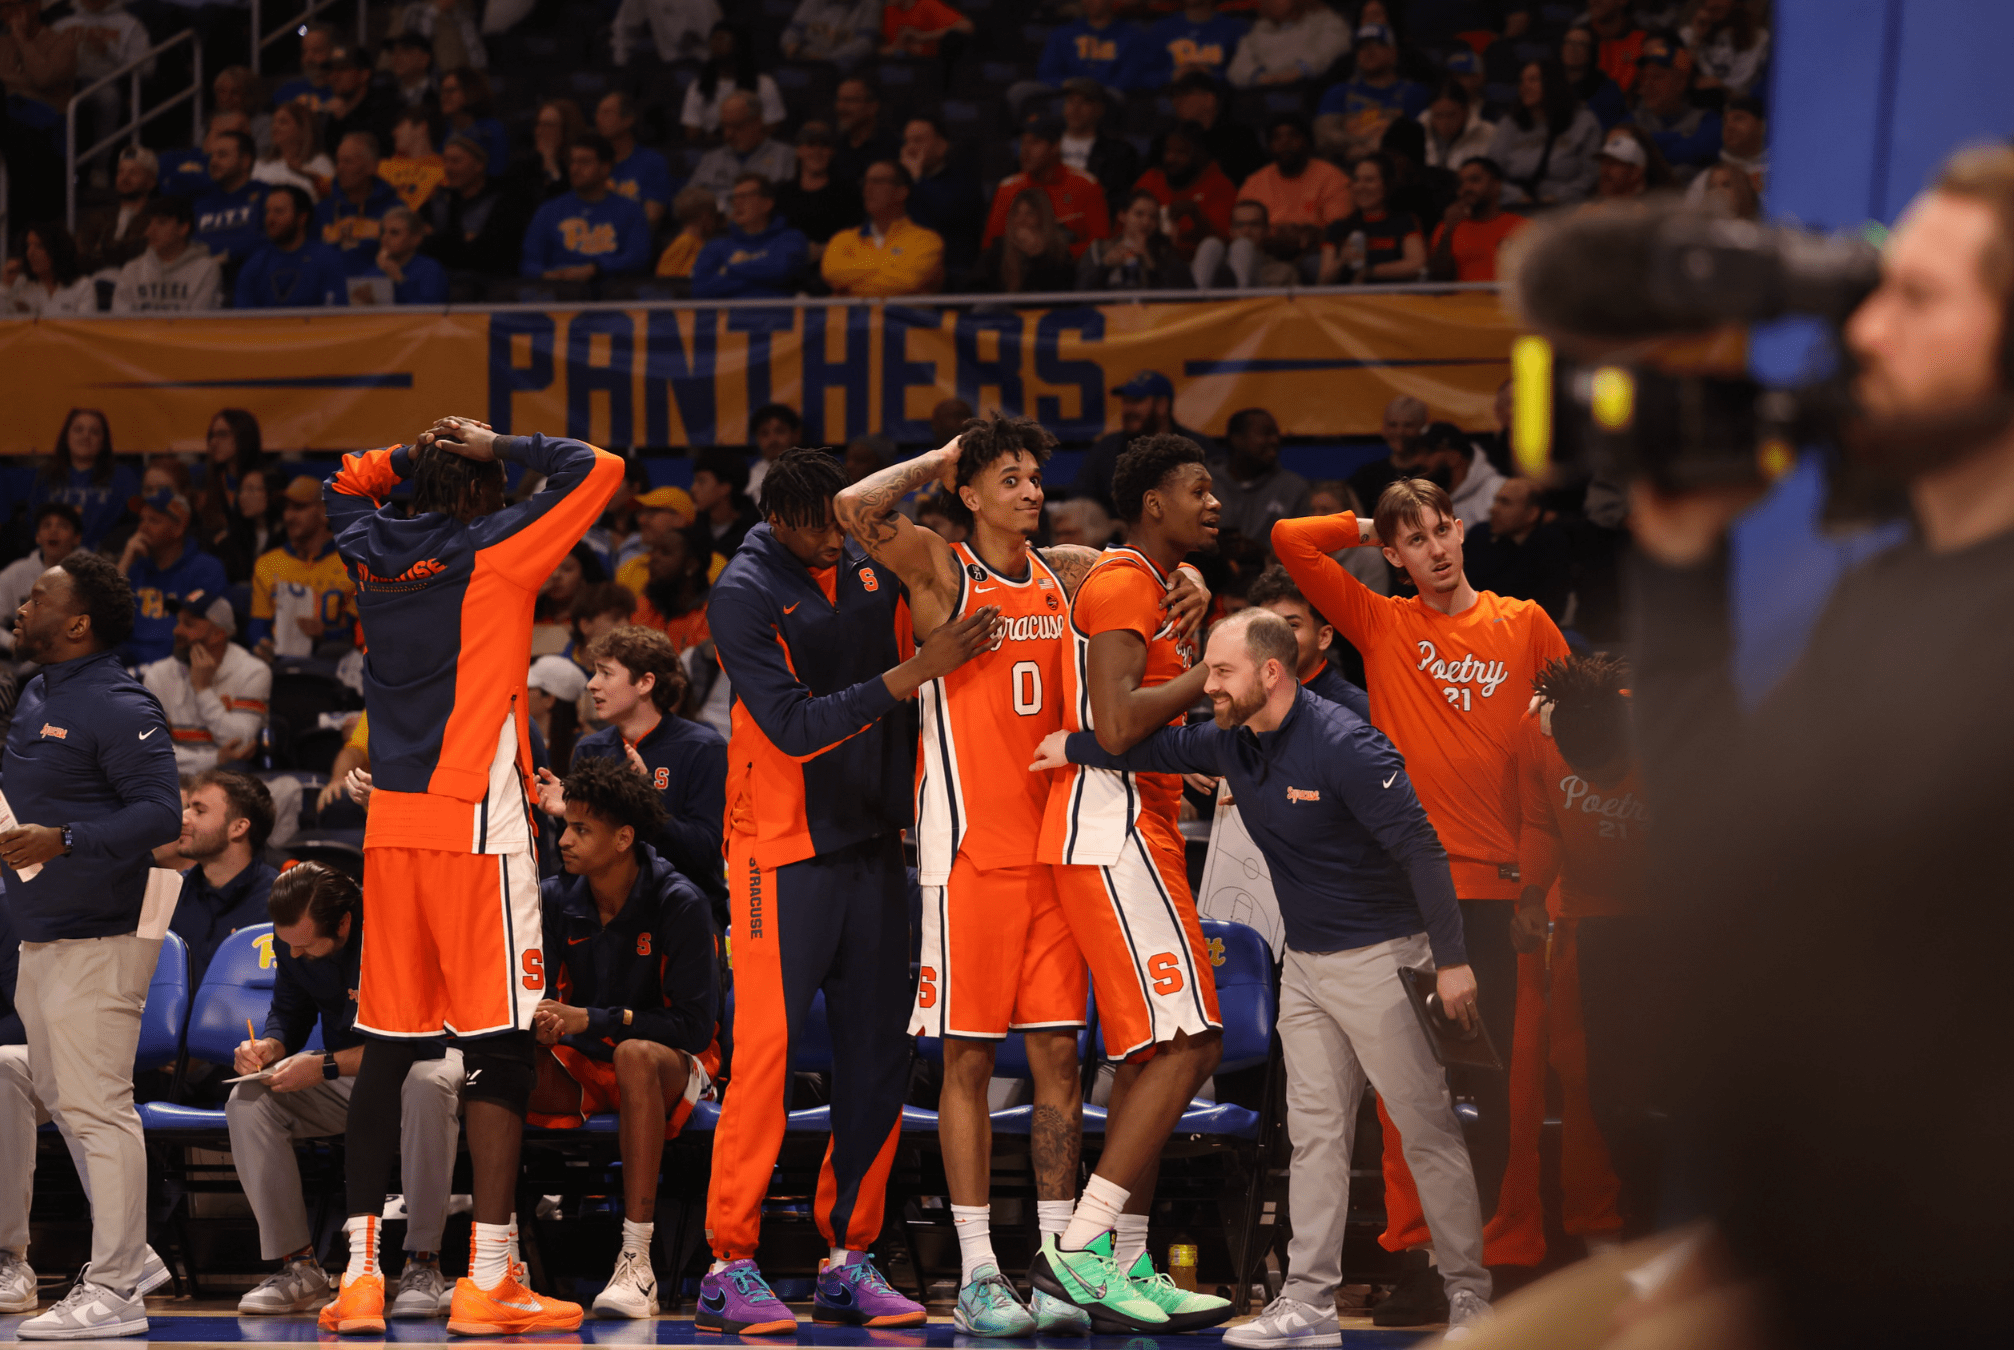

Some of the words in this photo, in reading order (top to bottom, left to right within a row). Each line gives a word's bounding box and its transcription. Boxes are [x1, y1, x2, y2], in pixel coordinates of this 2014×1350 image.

[199, 205, 251, 231] PITT
[487, 306, 1107, 448] PANTHERS
[859, 567, 879, 592] S
[988, 613, 1064, 652] yracuse
[1012, 660, 1043, 716] 0
[1417, 639, 1509, 698] Poetry
[1442, 686, 1471, 712] 21
[654, 767, 670, 790] S
[1559, 774, 1646, 821] Poetr
[748, 857, 763, 940] SYRACUSE
[637, 932, 652, 956] S
[521, 948, 544, 990] S
[919, 965, 937, 1009] S
[1147, 951, 1184, 996] S
